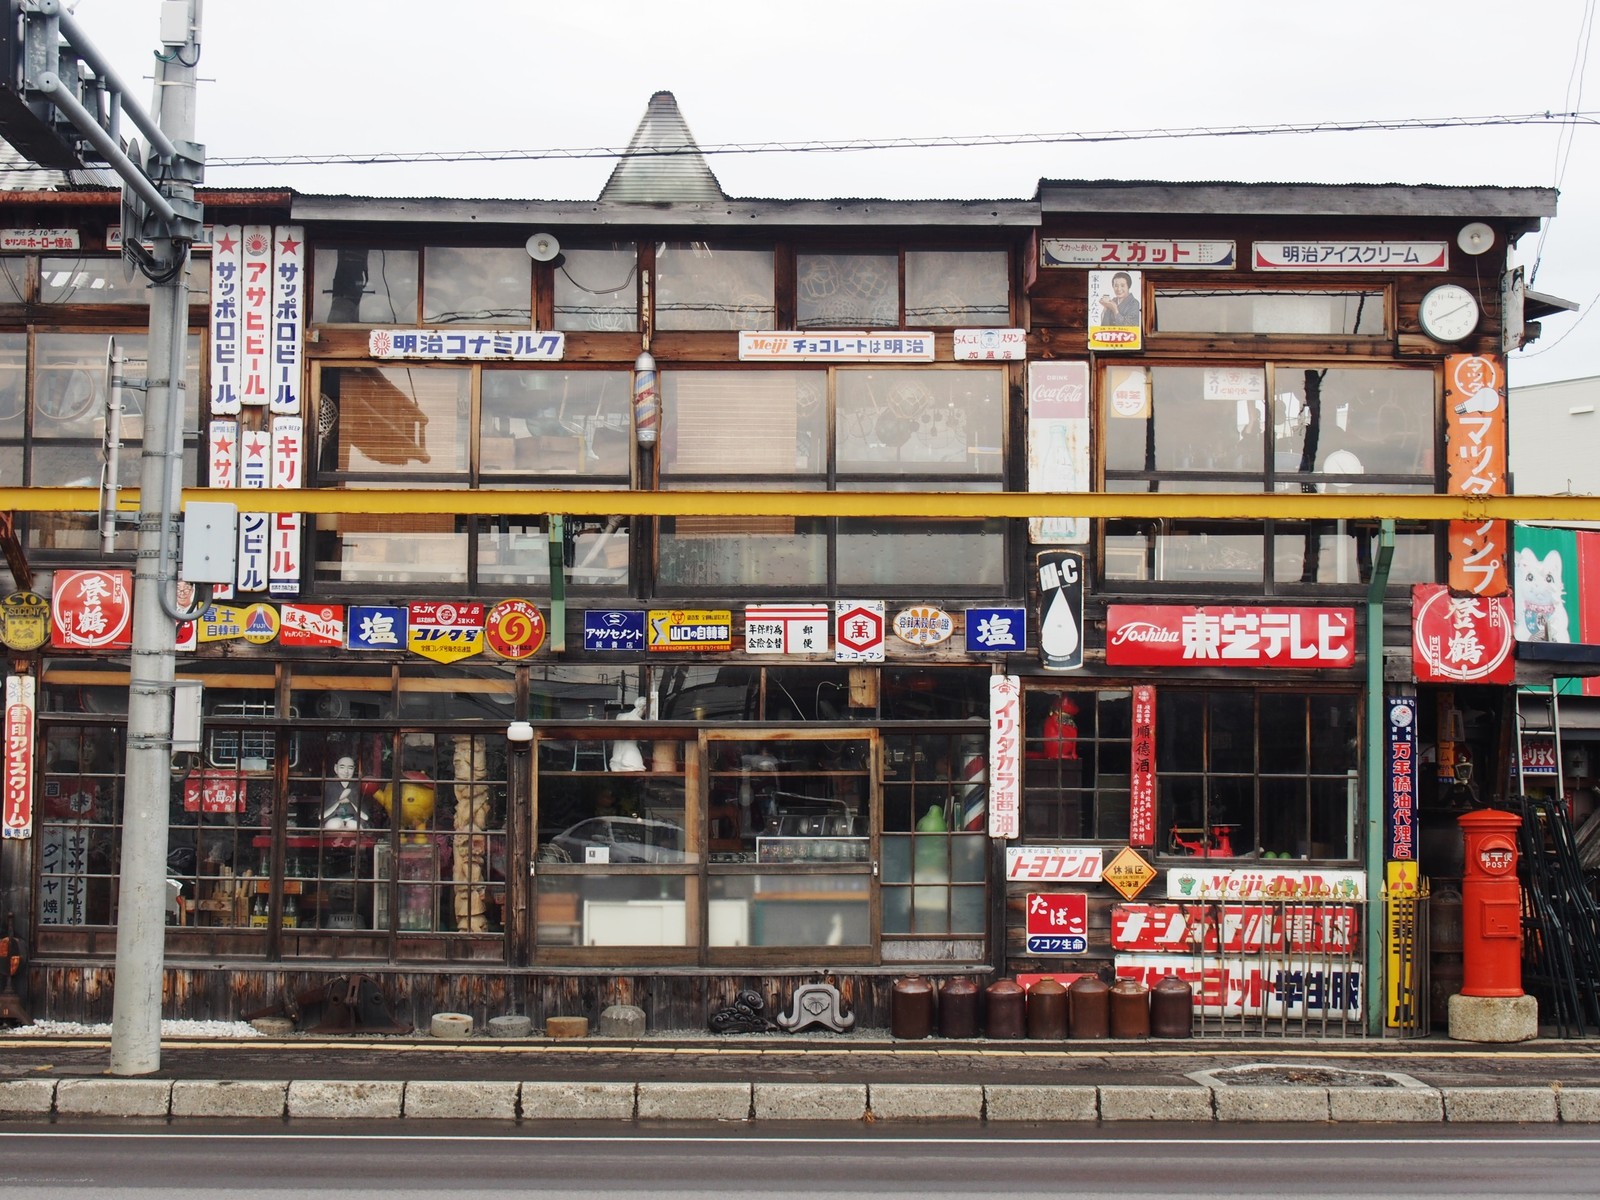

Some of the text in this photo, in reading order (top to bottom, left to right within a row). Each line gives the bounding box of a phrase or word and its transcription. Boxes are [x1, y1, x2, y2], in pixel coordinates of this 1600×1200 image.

[1100, 242, 1191, 263] スカット
[1282, 246, 1420, 263] 明治アイスクリーム
[214, 261, 237, 404] サッポロビール
[245, 262, 267, 395] アサヒビール
[274, 262, 299, 404] サッポロビール
[393, 335, 561, 355] 明治コナミルク
[748, 339, 924, 356] Meiji チョコレートは明治
[967, 350, 1013, 360] 加盟店
[1032, 384, 1083, 403] Coca-Cola
[273, 436, 298, 574] キリビール
[242, 463, 265, 588] ニッンビール
[8, 607, 41, 616] SOCONY
[75, 575, 111, 634] 登鶴
[203, 606, 236, 622] 富士
[411, 605, 436, 614] SJK
[837, 603, 853, 611] 天下
[285, 611, 340, 637] 阪東ベルト
[359, 611, 399, 644] 塩
[586, 628, 643, 640] アサノセメント
[976, 613, 1017, 647] 塩
[1444, 598, 1487, 665] 登鶴
[803, 624, 813, 649] 郵便
[1111, 613, 1349, 659] Toshiba 東芝テレビ
[837, 652, 883, 660] キッコーマン
[9, 706, 28, 827] 雪印アイスクリーム
[995, 699, 1016, 833] イリタカラ醤油
[1392, 742, 1412, 860] 万年椿油代理店
[4, 828, 31, 838] 販売店
[1011, 856, 1100, 878] トヨコンロ
[1486, 861, 1508, 869] POST
[1030, 895, 1084, 934] たばこ
[1031, 938, 1084, 950] フコク生命
